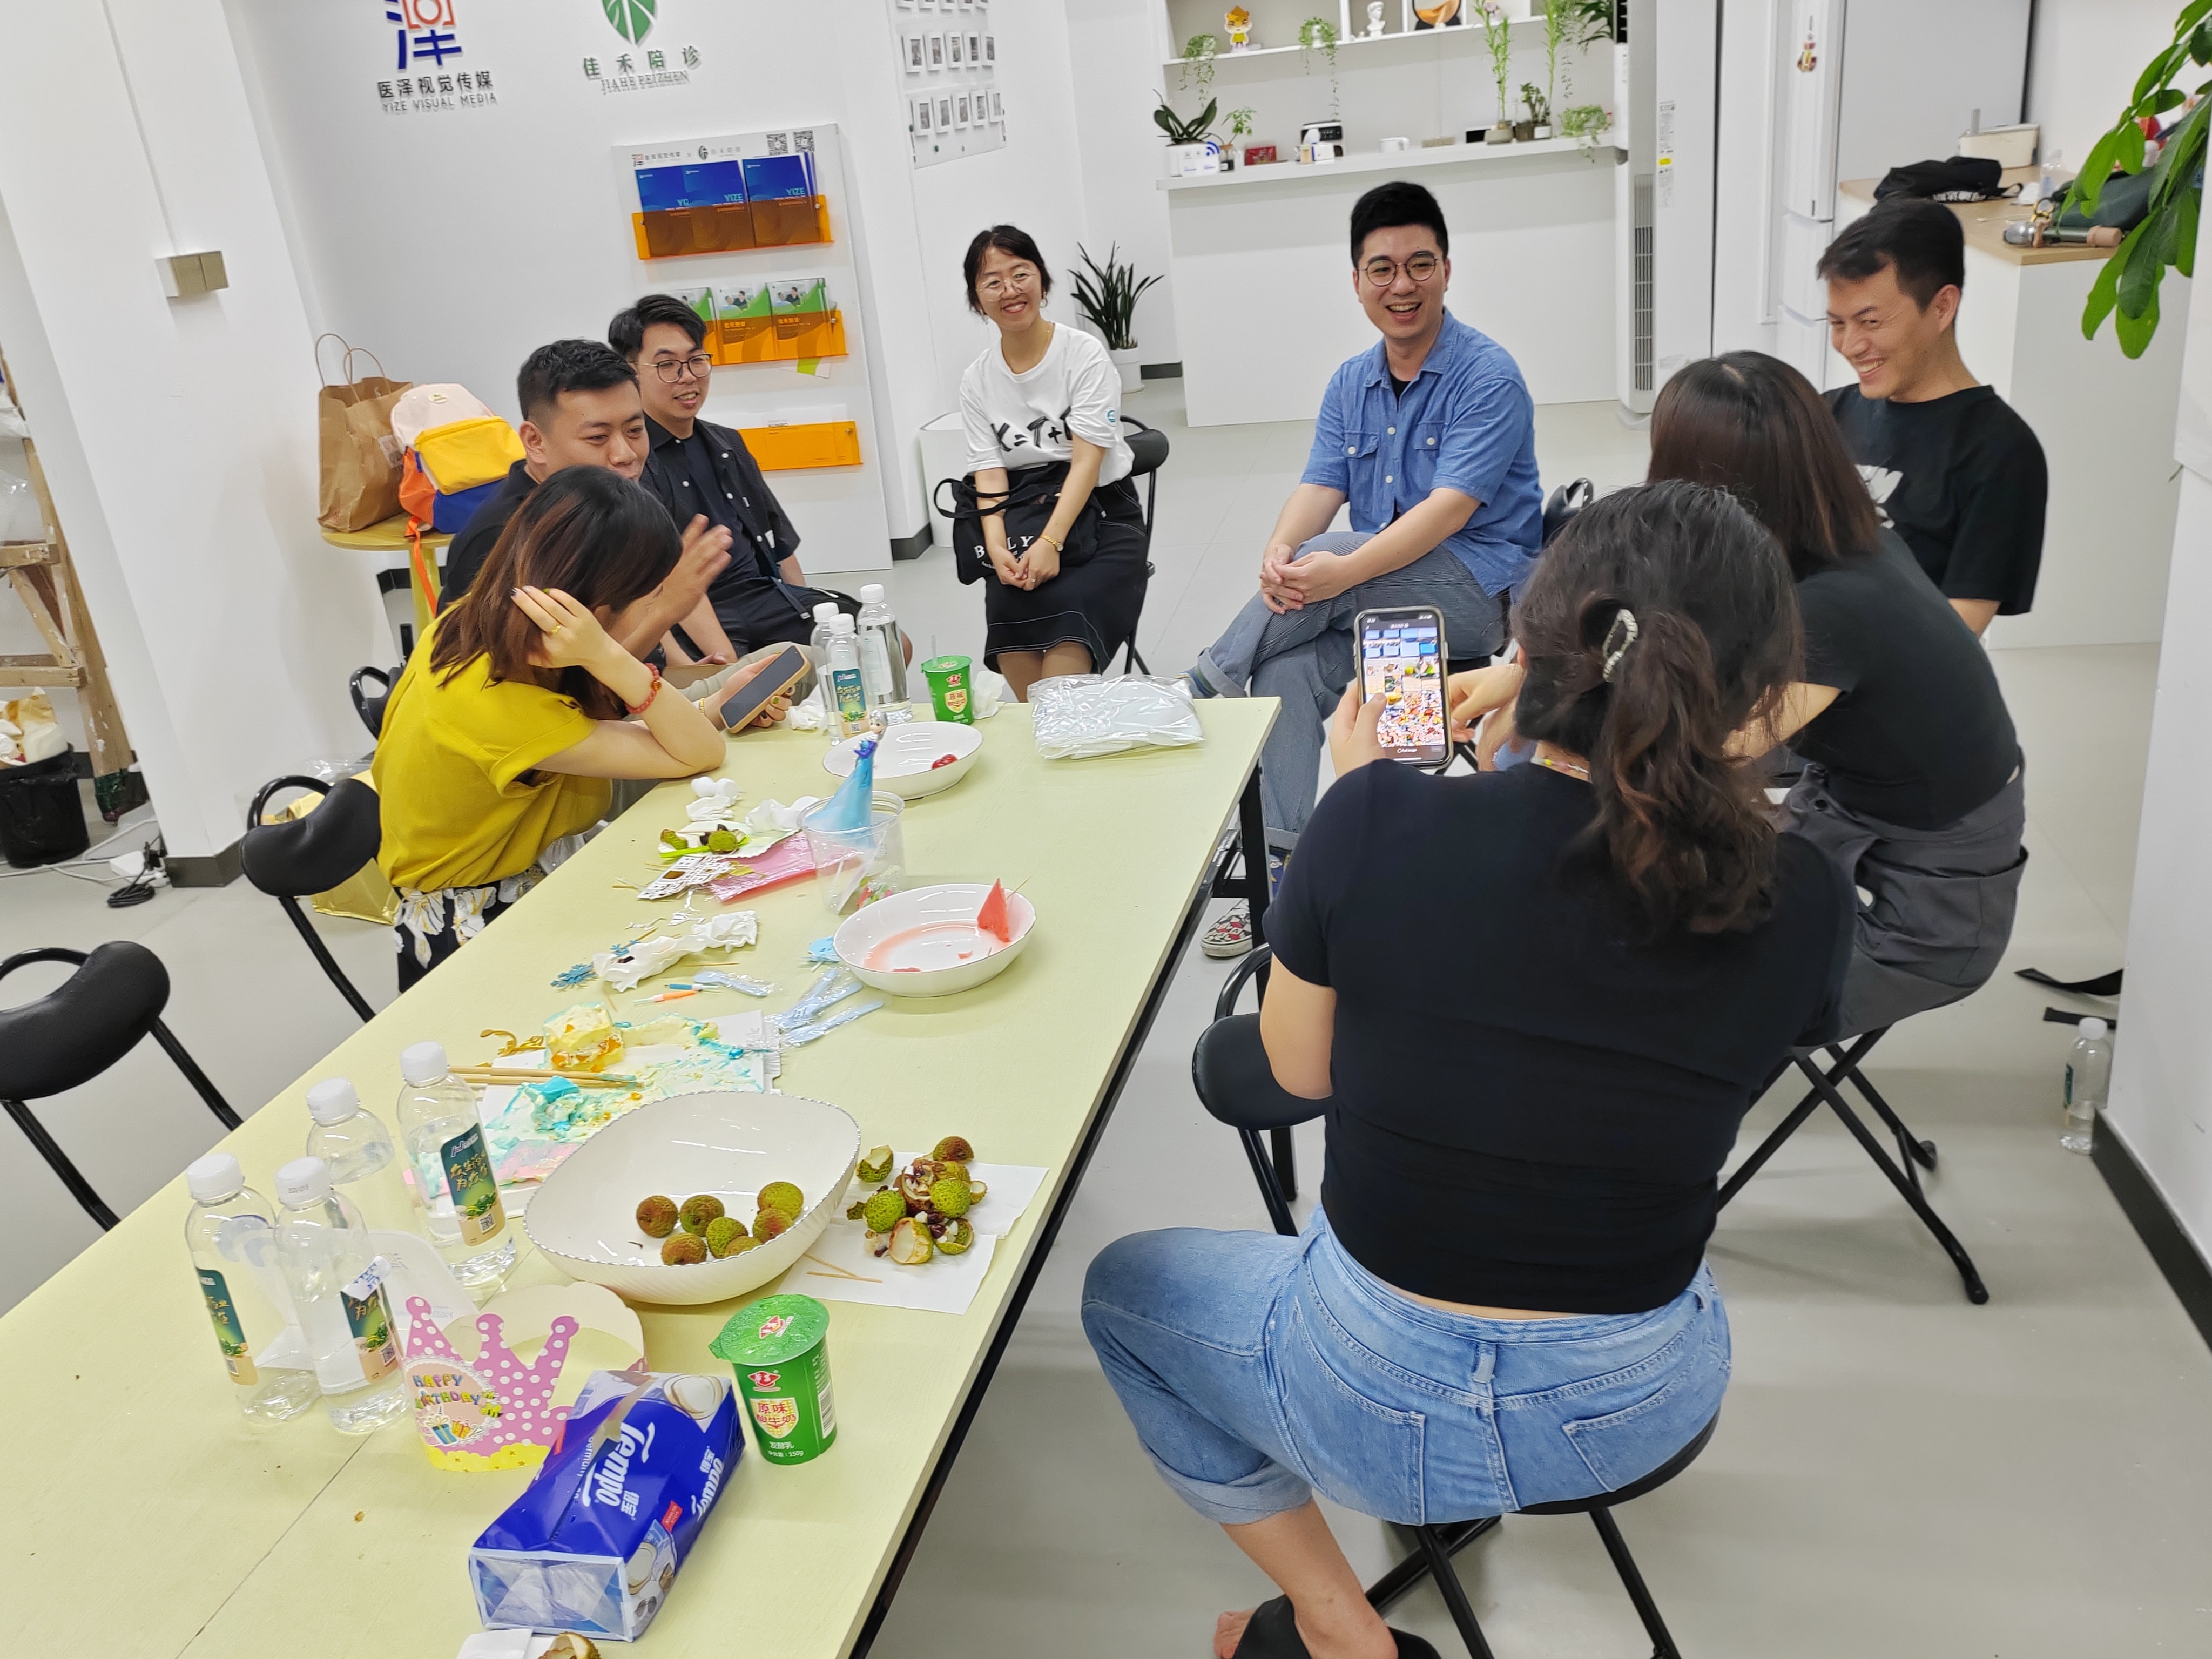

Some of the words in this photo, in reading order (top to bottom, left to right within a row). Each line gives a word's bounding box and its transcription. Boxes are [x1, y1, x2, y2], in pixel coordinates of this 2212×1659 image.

[583, 45, 699, 76] 佳禾陪诊
[377, 71, 493, 98] 医泽视觉传媒
[382, 101, 407, 112] YIZE
[413, 98, 454, 109] VISUAL
[460, 93, 496, 105] MEDIA
[413, 1373, 463, 1387] HAPPY
[758, 1403, 788, 1413] 原味
[583, 1421, 656, 1507] Tempo
